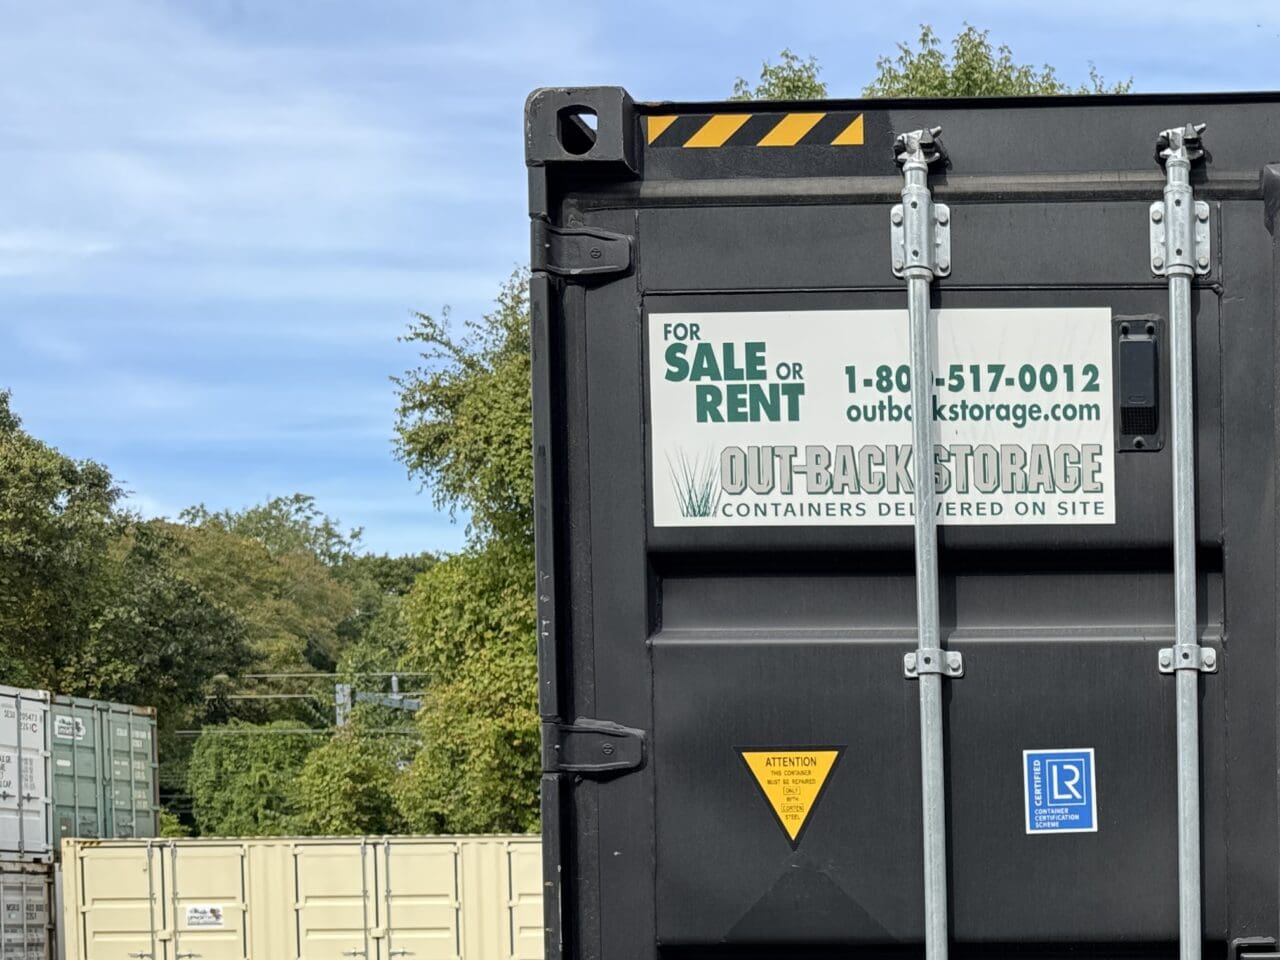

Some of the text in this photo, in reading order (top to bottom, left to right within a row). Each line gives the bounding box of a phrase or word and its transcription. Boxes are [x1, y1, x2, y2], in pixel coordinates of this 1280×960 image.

[663, 322, 701, 341] FOR
[664, 341, 804, 383] SALE OR
[844, 363, 1100, 393] 1-80-517-0012
[695, 382, 805, 423] RENT
[846, 394, 1100, 428] outbkstorage.com
[720, 443, 1104, 495] OUT-BACK STORAGE
[722, 501, 1105, 518] CONTAINERS DELERED ON SITE
[765, 756, 817, 767] ATTENTION
[1033, 759, 1042, 807] CERTIFIED
[1052, 764, 1082, 800] LR
[1034, 814, 1080, 822] CERTIFICATION
